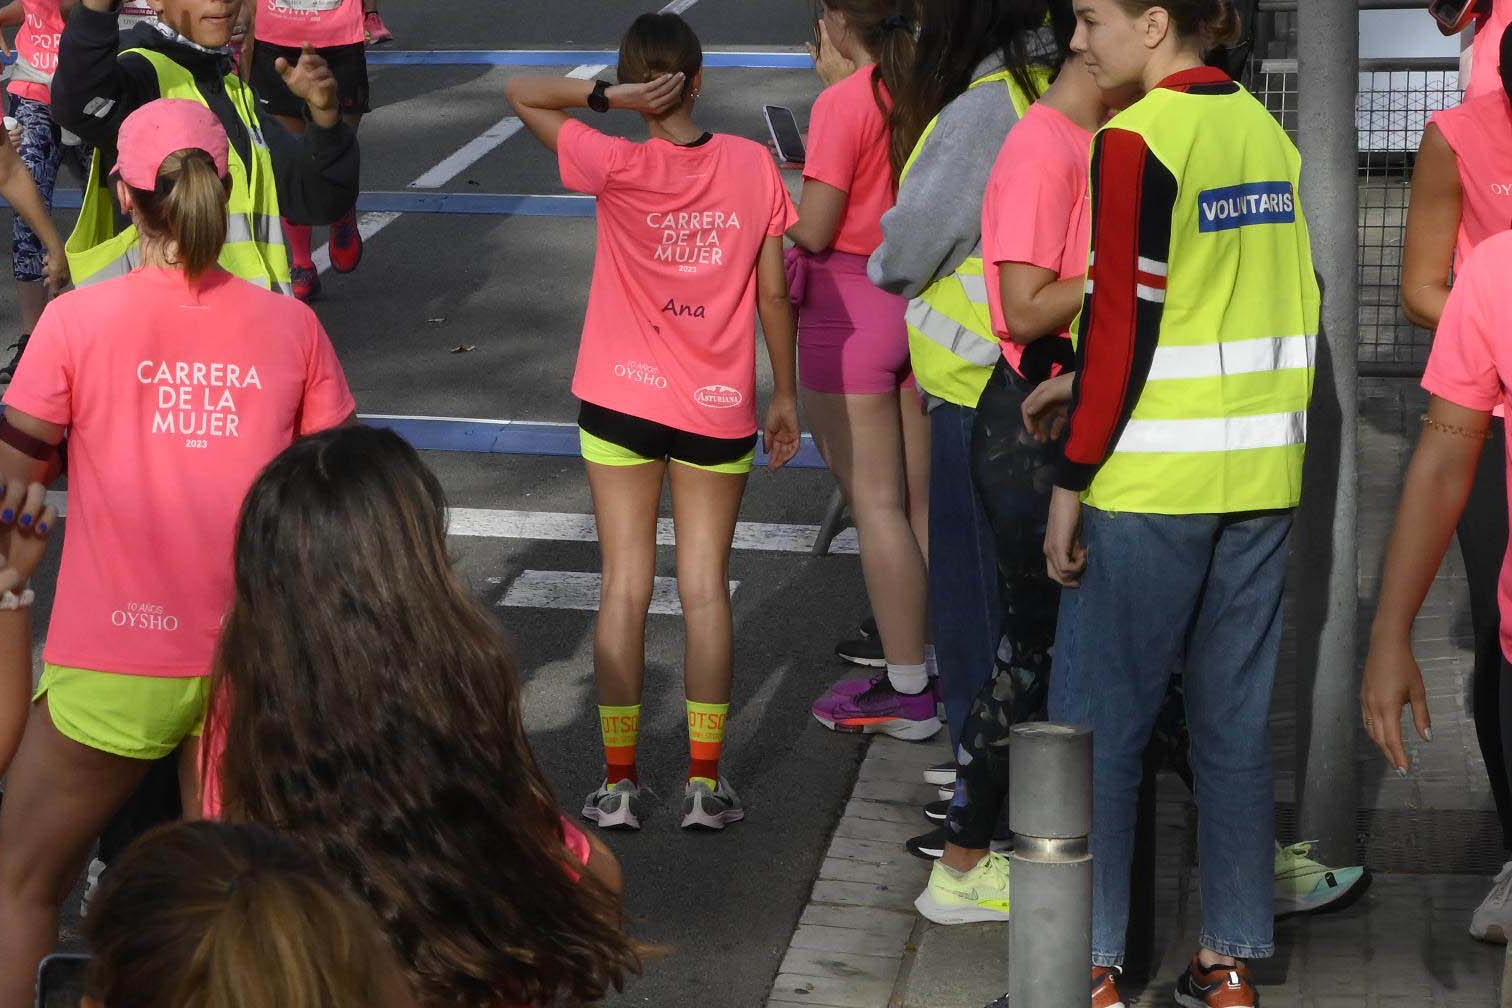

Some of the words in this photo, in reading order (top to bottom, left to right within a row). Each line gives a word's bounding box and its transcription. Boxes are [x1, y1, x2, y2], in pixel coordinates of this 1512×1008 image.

[647, 211, 741, 229] CARRERA
[662, 230, 688, 246] DE
[696, 230, 720, 246] LA
[653, 247, 723, 265] MUJER
[662, 298, 705, 319] Ana
[137, 360, 262, 390] CARRERA
[614, 364, 667, 389] OYSHO
[158, 386, 192, 410] DE
[204, 388, 236, 412] LA
[152, 411, 239, 437] MUJER
[185, 439, 208, 449] 2023
[111, 610, 178, 632] OYSHO
